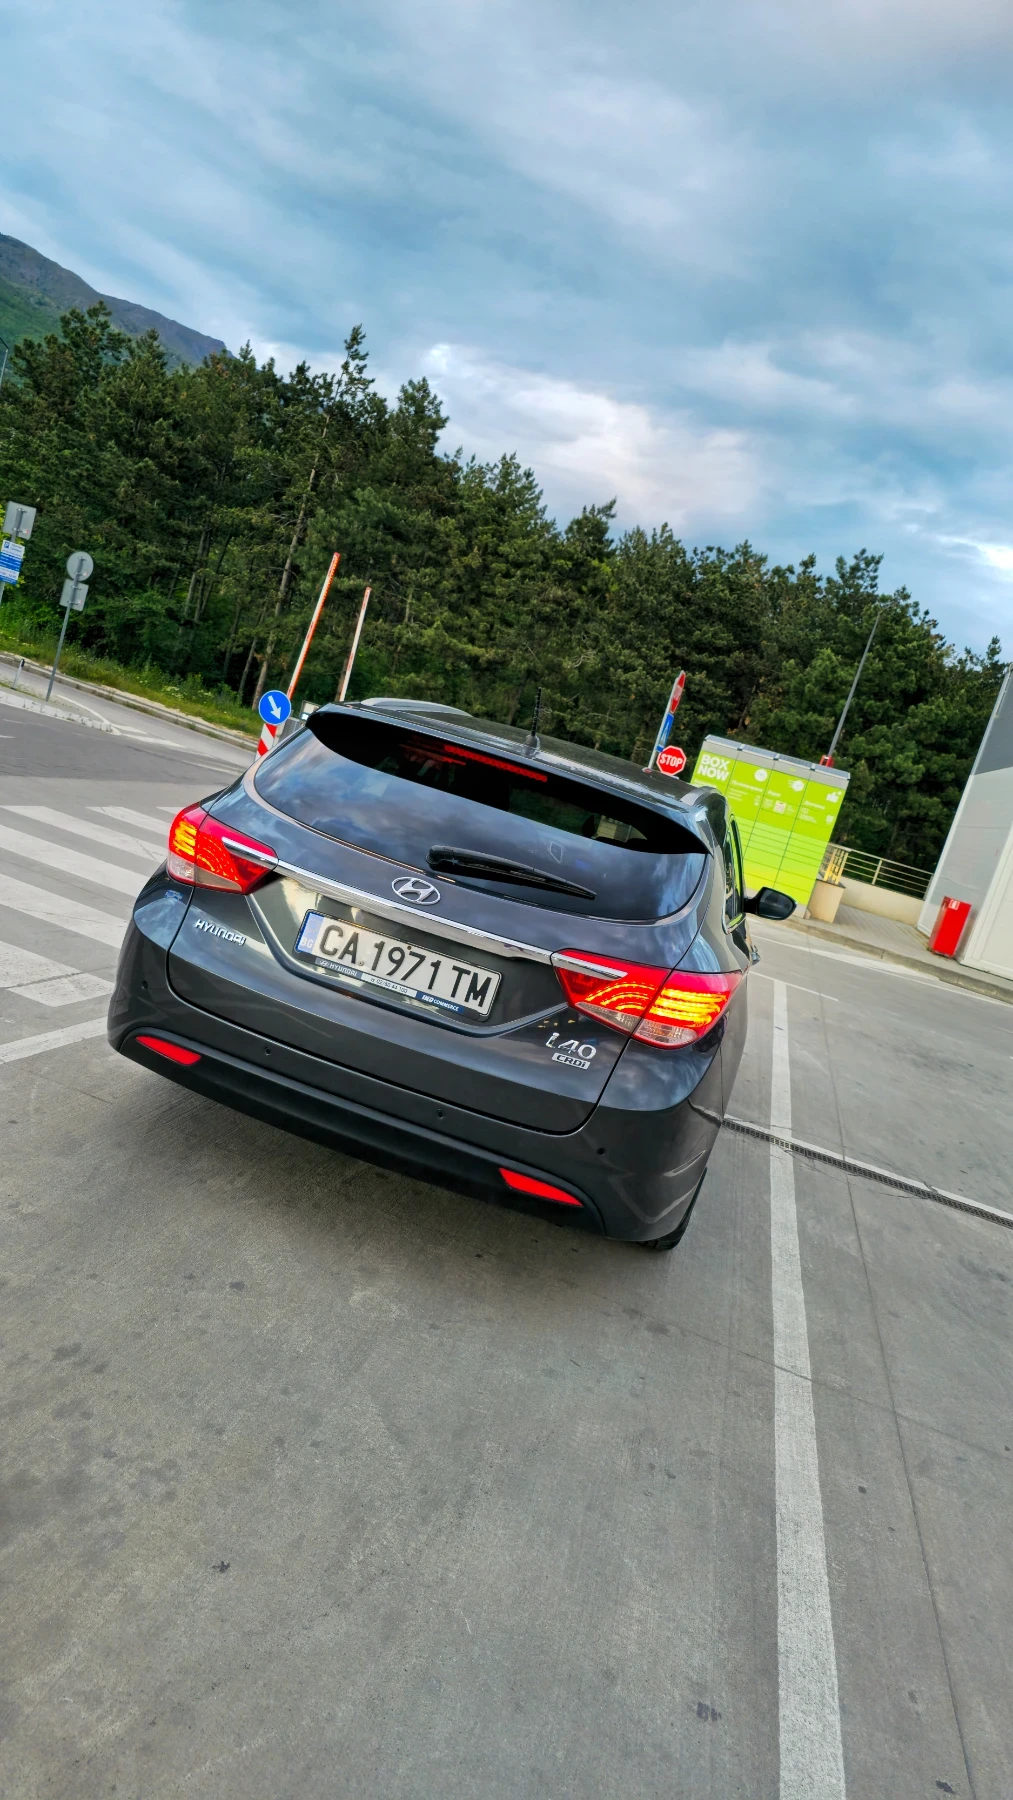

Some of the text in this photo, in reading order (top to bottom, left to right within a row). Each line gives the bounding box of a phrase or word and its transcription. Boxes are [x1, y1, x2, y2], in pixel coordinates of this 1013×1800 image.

[659, 753, 683, 768] STOP
[701, 754, 730, 771] BOX
[698, 764, 730, 781] NOW
[194, 919, 247, 946] HYUNDAI
[300, 936, 314, 949] BG
[319, 924, 493, 1008] CA 1971 TM
[329, 962, 358, 977] HYUNDAI
[433, 998, 460, 1012] COMMERCE
